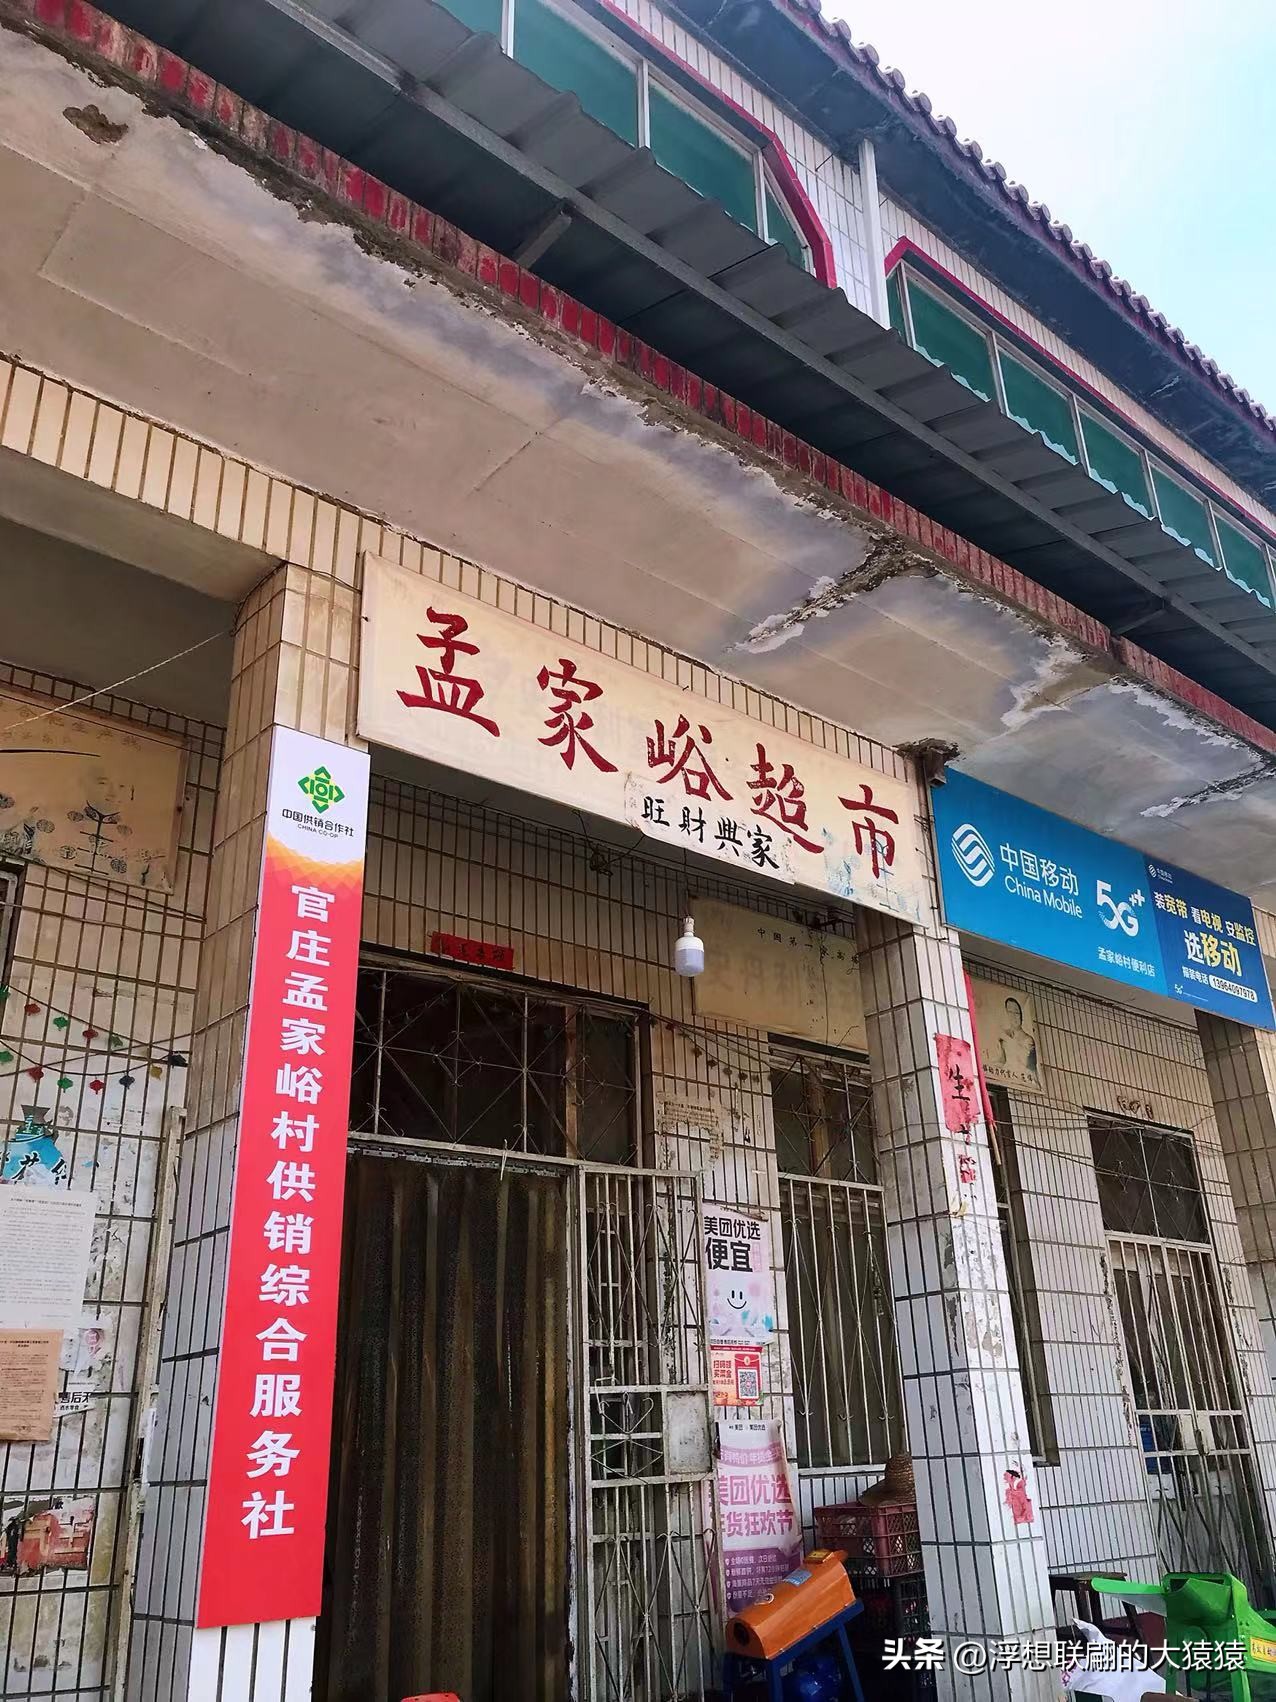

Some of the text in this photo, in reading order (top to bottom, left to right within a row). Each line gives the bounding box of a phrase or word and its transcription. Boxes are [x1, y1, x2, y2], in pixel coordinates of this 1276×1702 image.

[396, 606, 900, 880] 孟家峪超市
[282, 809, 354, 837] 中国供销合作社
[298, 823, 317, 833] CHINA
[1000, 843, 1079, 896] 中国移动
[1005, 875, 1083, 919] China Mobile
[1154, 891, 1256, 946] 装宽带 看电视 安监控
[1097, 946, 1156, 977] 孟家峪村便利店
[1184, 929, 1242, 976] 选移动
[240, 884, 336, 1541] 官庄孟家峪村供销综合服务社
[703, 1216, 760, 1240] 美团优选
[705, 1237, 753, 1272] 便宜
